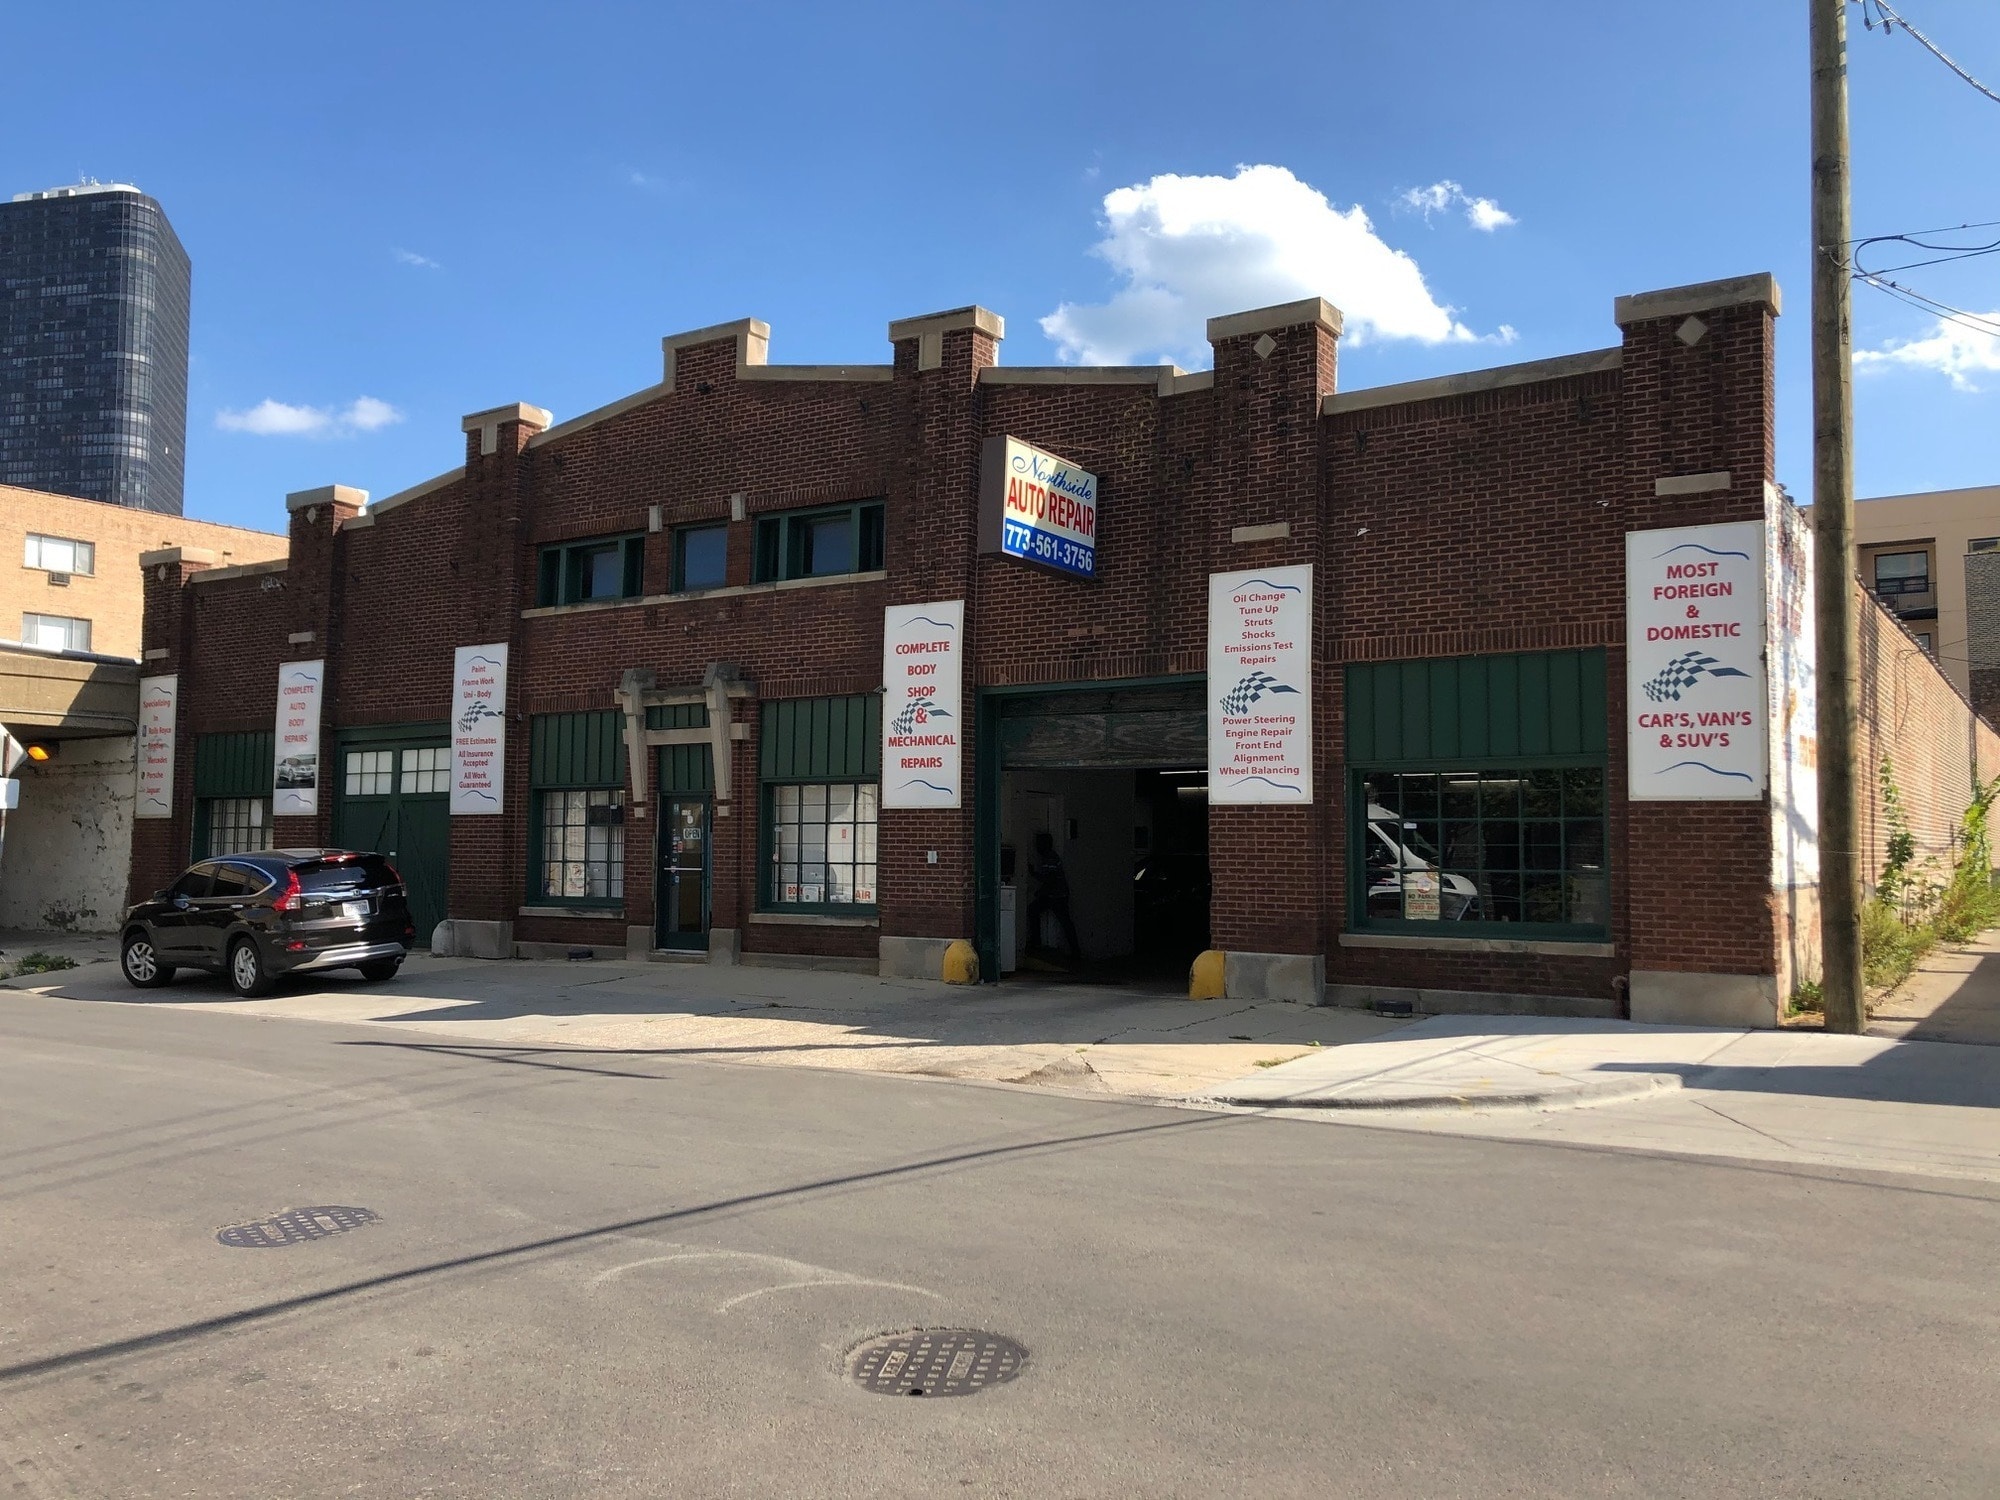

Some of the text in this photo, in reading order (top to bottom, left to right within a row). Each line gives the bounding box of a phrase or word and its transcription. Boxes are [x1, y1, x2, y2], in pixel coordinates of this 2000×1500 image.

[1012, 455, 1092, 500] Northside
[1007, 477, 1095, 538] AUTO REPAIR
[1006, 524, 1093, 571] 773-561-3756
[1667, 562, 1719, 579] MOST
[1653, 582, 1733, 600] FOREIGN
[1233, 592, 1286, 603] Oil Change
[1239, 605, 1279, 615] Tune Up
[1686, 605, 1700, 619] &
[1244, 618, 1273, 627] Struts
[1241, 630, 1276, 640] Shocks
[1647, 623, 1741, 641] DOMESTIC
[895, 641, 950, 655] COMPLETE
[1224, 641, 1294, 653] Emissions Test
[1240, 655, 1277, 666] Repairs
[471, 665, 487, 674] Paint
[907, 664, 937, 676] BODY
[462, 676, 495, 687] Frame Work
[283, 685, 314, 695] COMPLETE
[463, 691, 474, 699] Uni
[477, 690, 492, 699] Body
[907, 686, 936, 698] SHOP
[289, 702, 306, 711] AUTO
[915, 708, 927, 724] &
[1222, 715, 1296, 725] Power Steering
[1638, 711, 1752, 729] CAR'S, VAN'S
[288, 718, 305, 727] BODY
[284, 734, 308, 742] REPAIRS
[1225, 727, 1293, 739] Engine Repair
[455, 737, 497, 746] FREE Estimates
[888, 735, 956, 747] MECHANICAL
[1235, 740, 1282, 750] Front End
[1659, 732, 1730, 748] & SUV'S
[458, 749, 494, 759] All Insurance
[1233, 753, 1285, 764] Alignment
[462, 758, 489, 768] Accepted
[901, 757, 943, 769] REPAIRS
[464, 770, 487, 780] All Work
[1219, 766, 1300, 776] Wheel Balancing
[458, 781, 492, 789] Guaranteed
